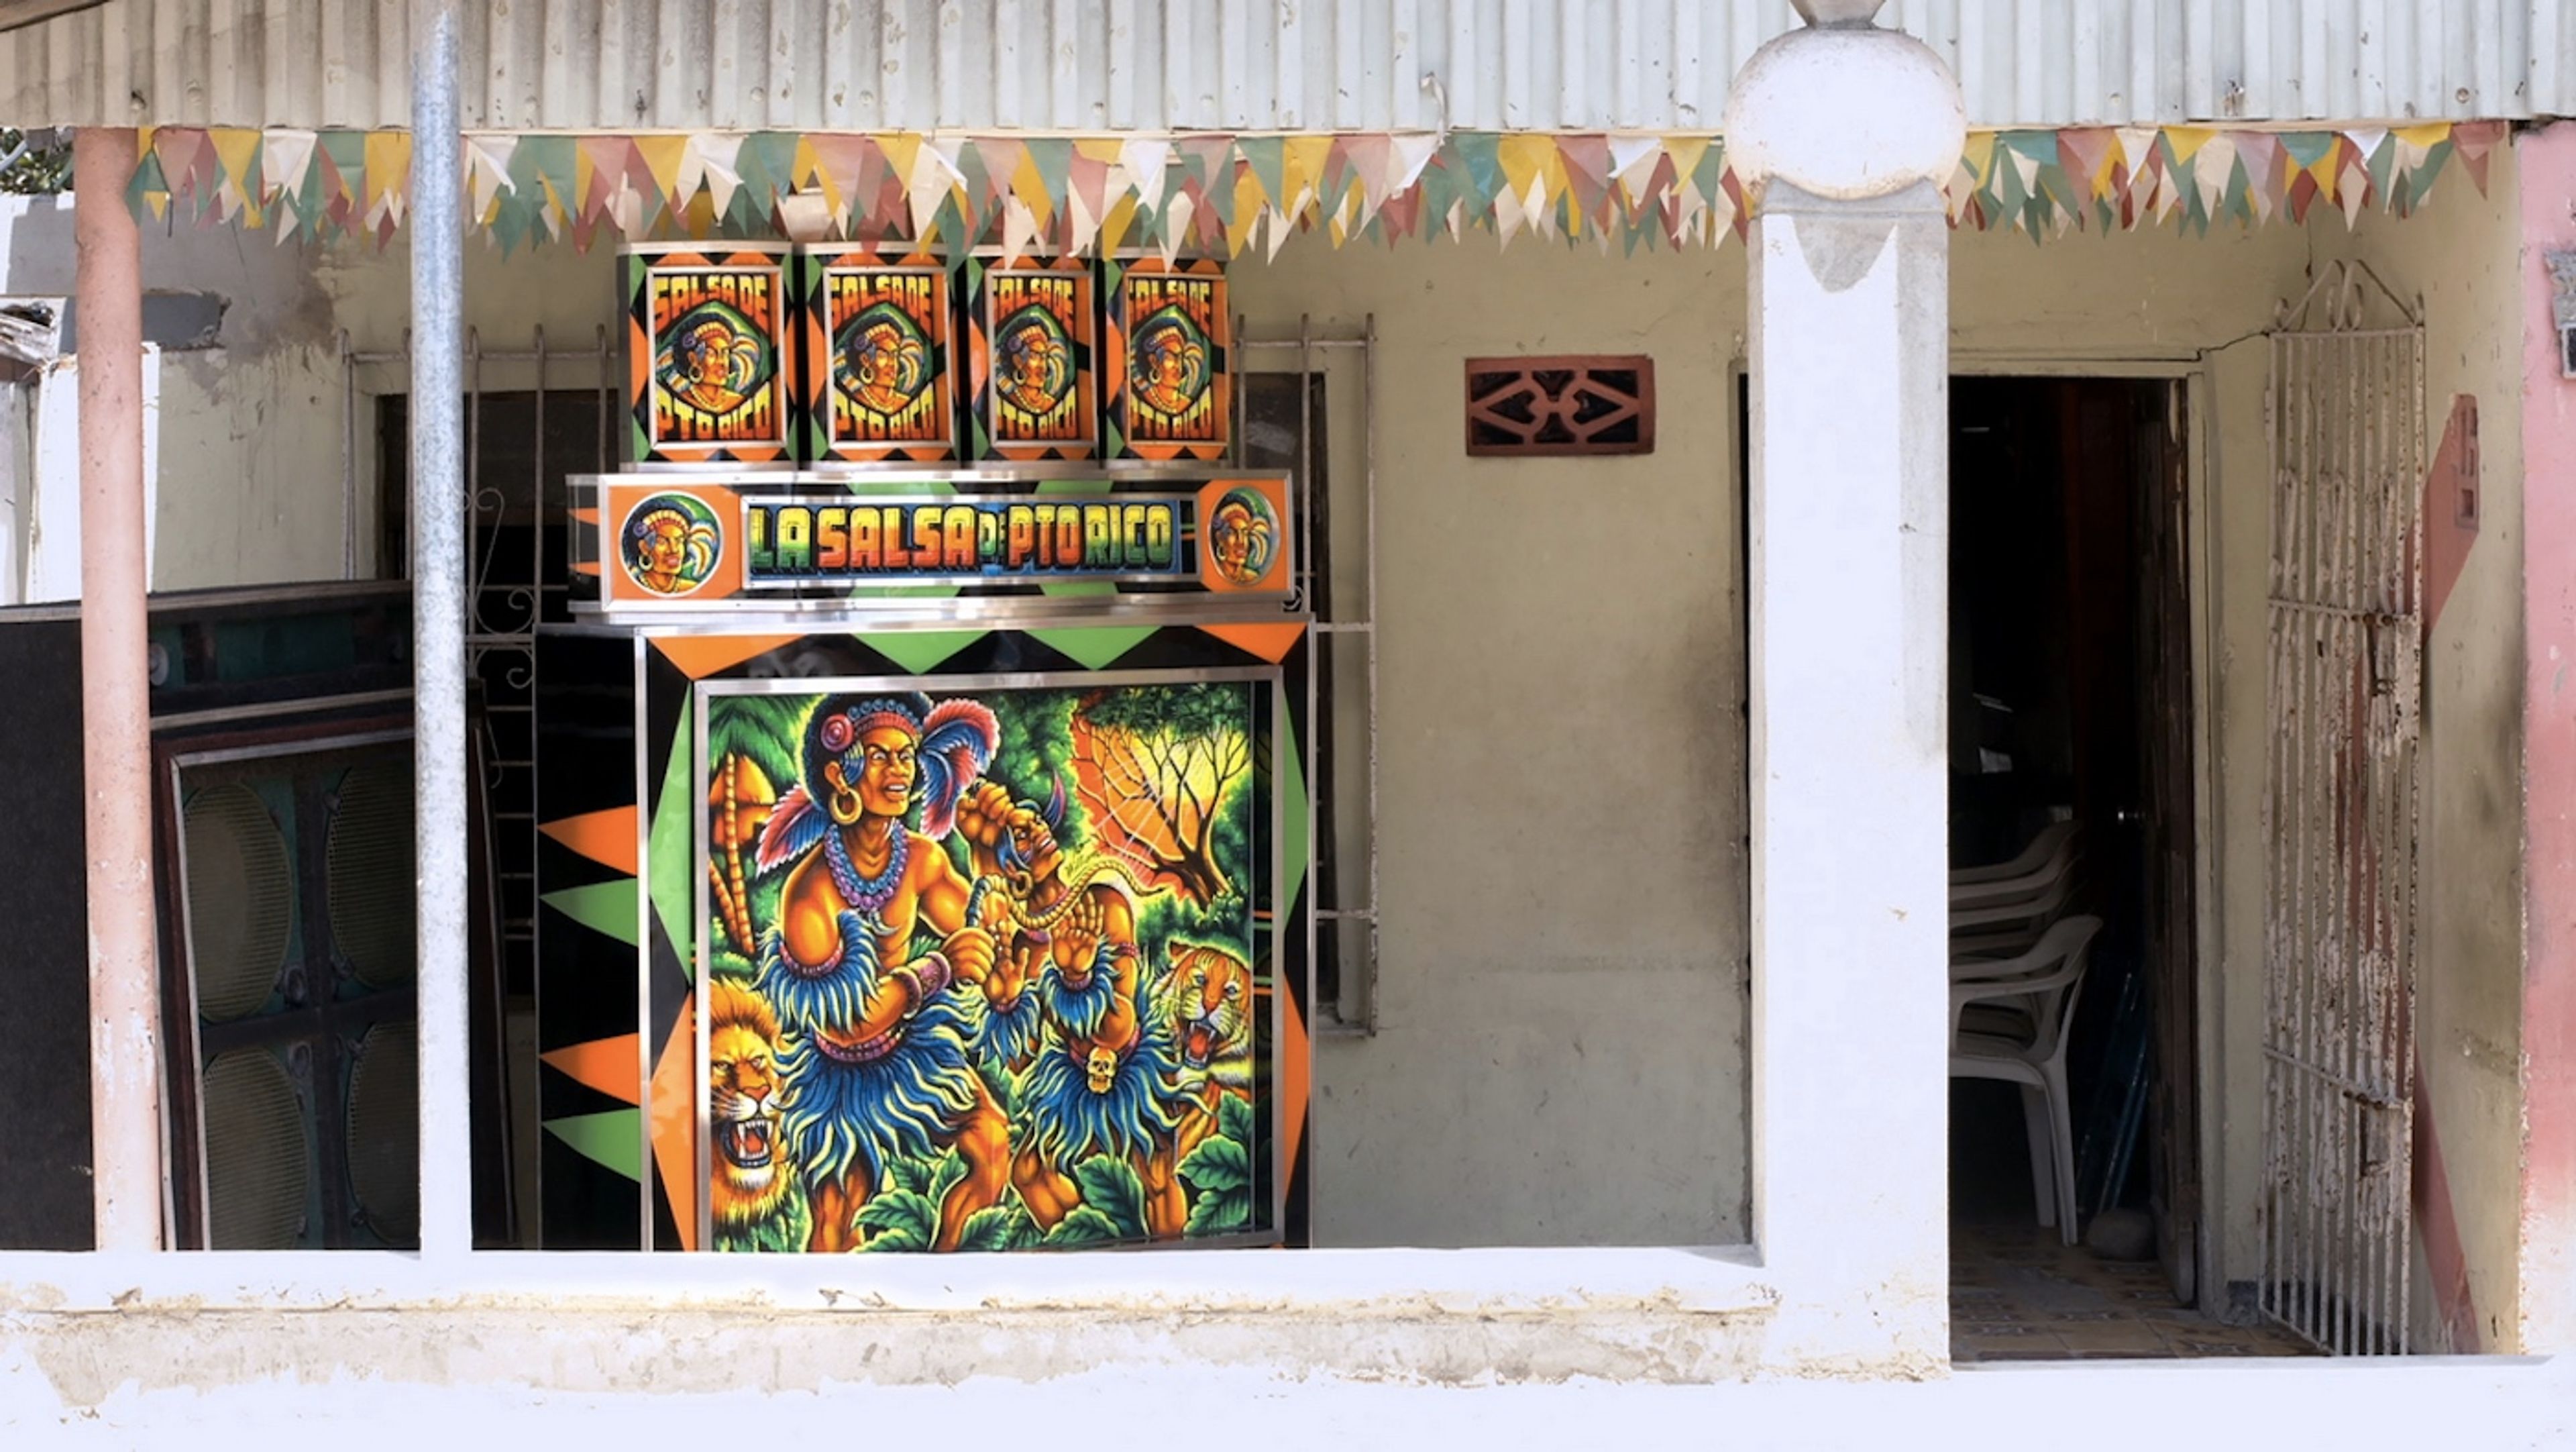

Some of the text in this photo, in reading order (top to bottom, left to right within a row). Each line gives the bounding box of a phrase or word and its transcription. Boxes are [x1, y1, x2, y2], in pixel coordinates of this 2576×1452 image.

[717, 380, 771, 441] RICO
[890, 382, 936, 440] RICO
[749, 507, 811, 568] LA
[817, 507, 975, 568] SALSA
[1008, 505, 1081, 567] PTO
[1083, 505, 1172, 566] RICO
